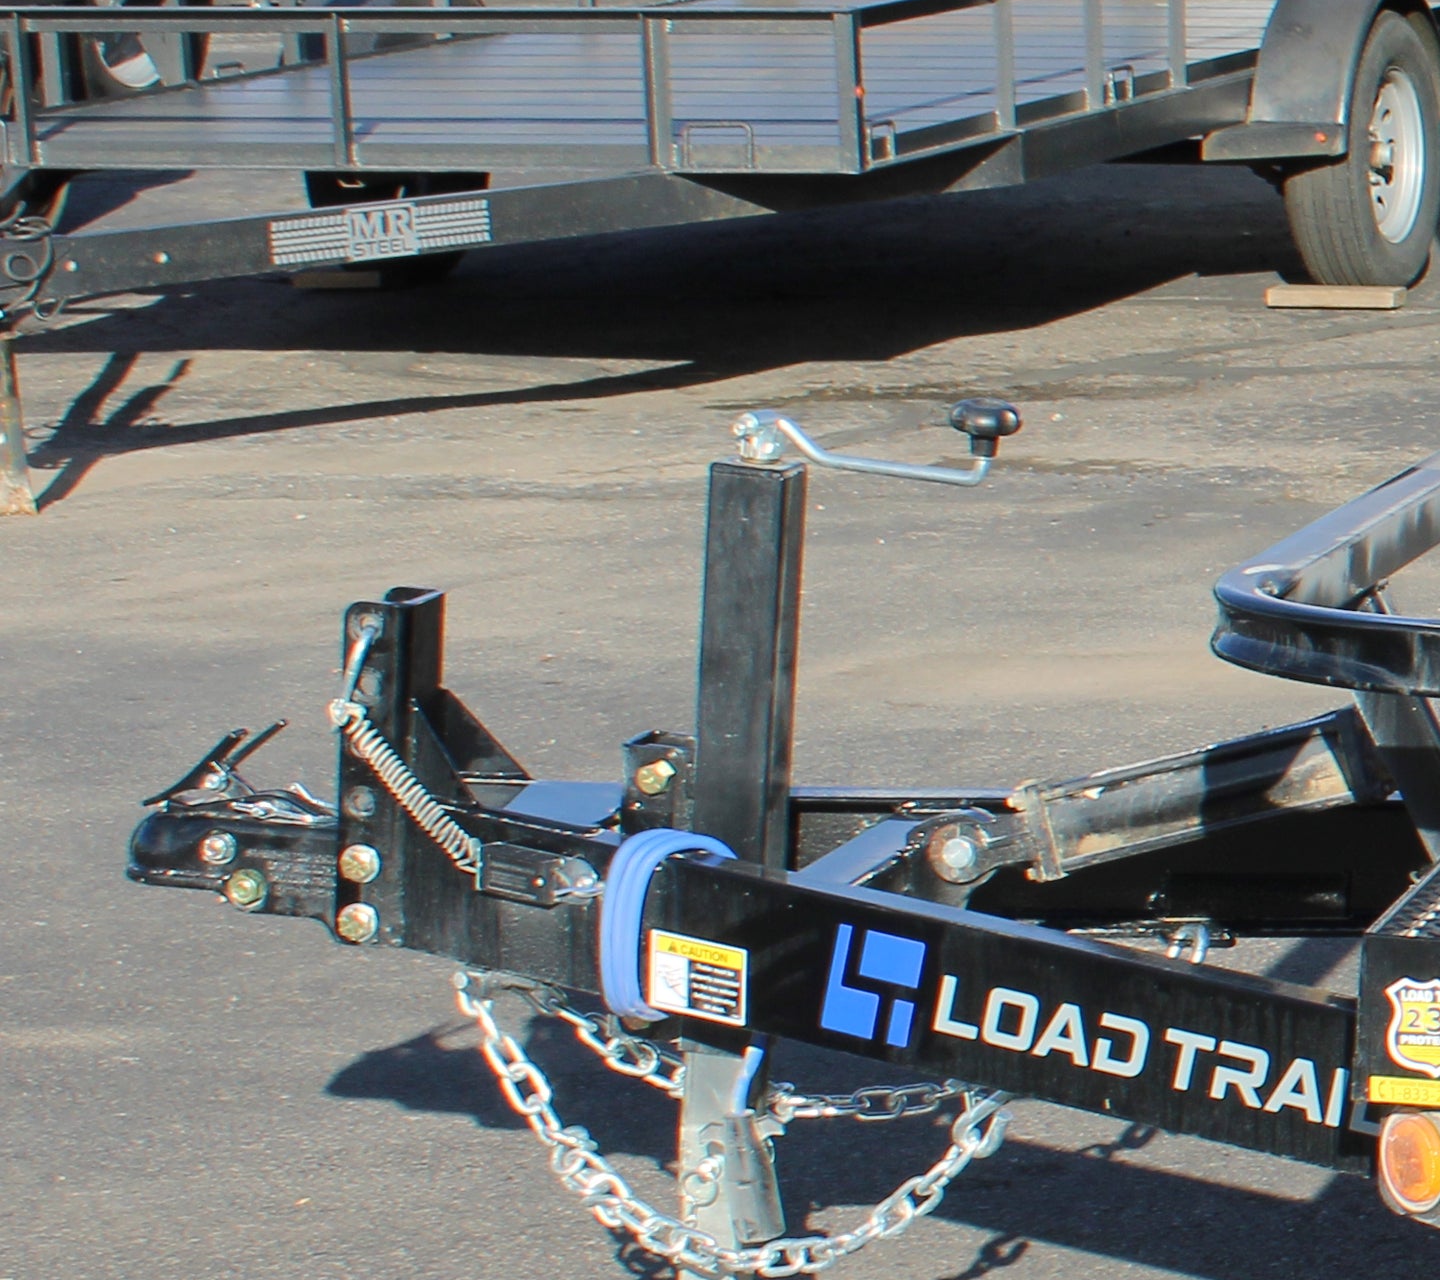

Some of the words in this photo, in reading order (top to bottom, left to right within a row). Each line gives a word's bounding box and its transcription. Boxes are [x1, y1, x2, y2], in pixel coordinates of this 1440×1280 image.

[351, 206, 413, 240] MR
[352, 239, 412, 259] STEEL
[680, 943, 728, 963] CAUTION
[1400, 989, 1434, 1003] LOAD
[931, 974, 1151, 1078] LOAD
